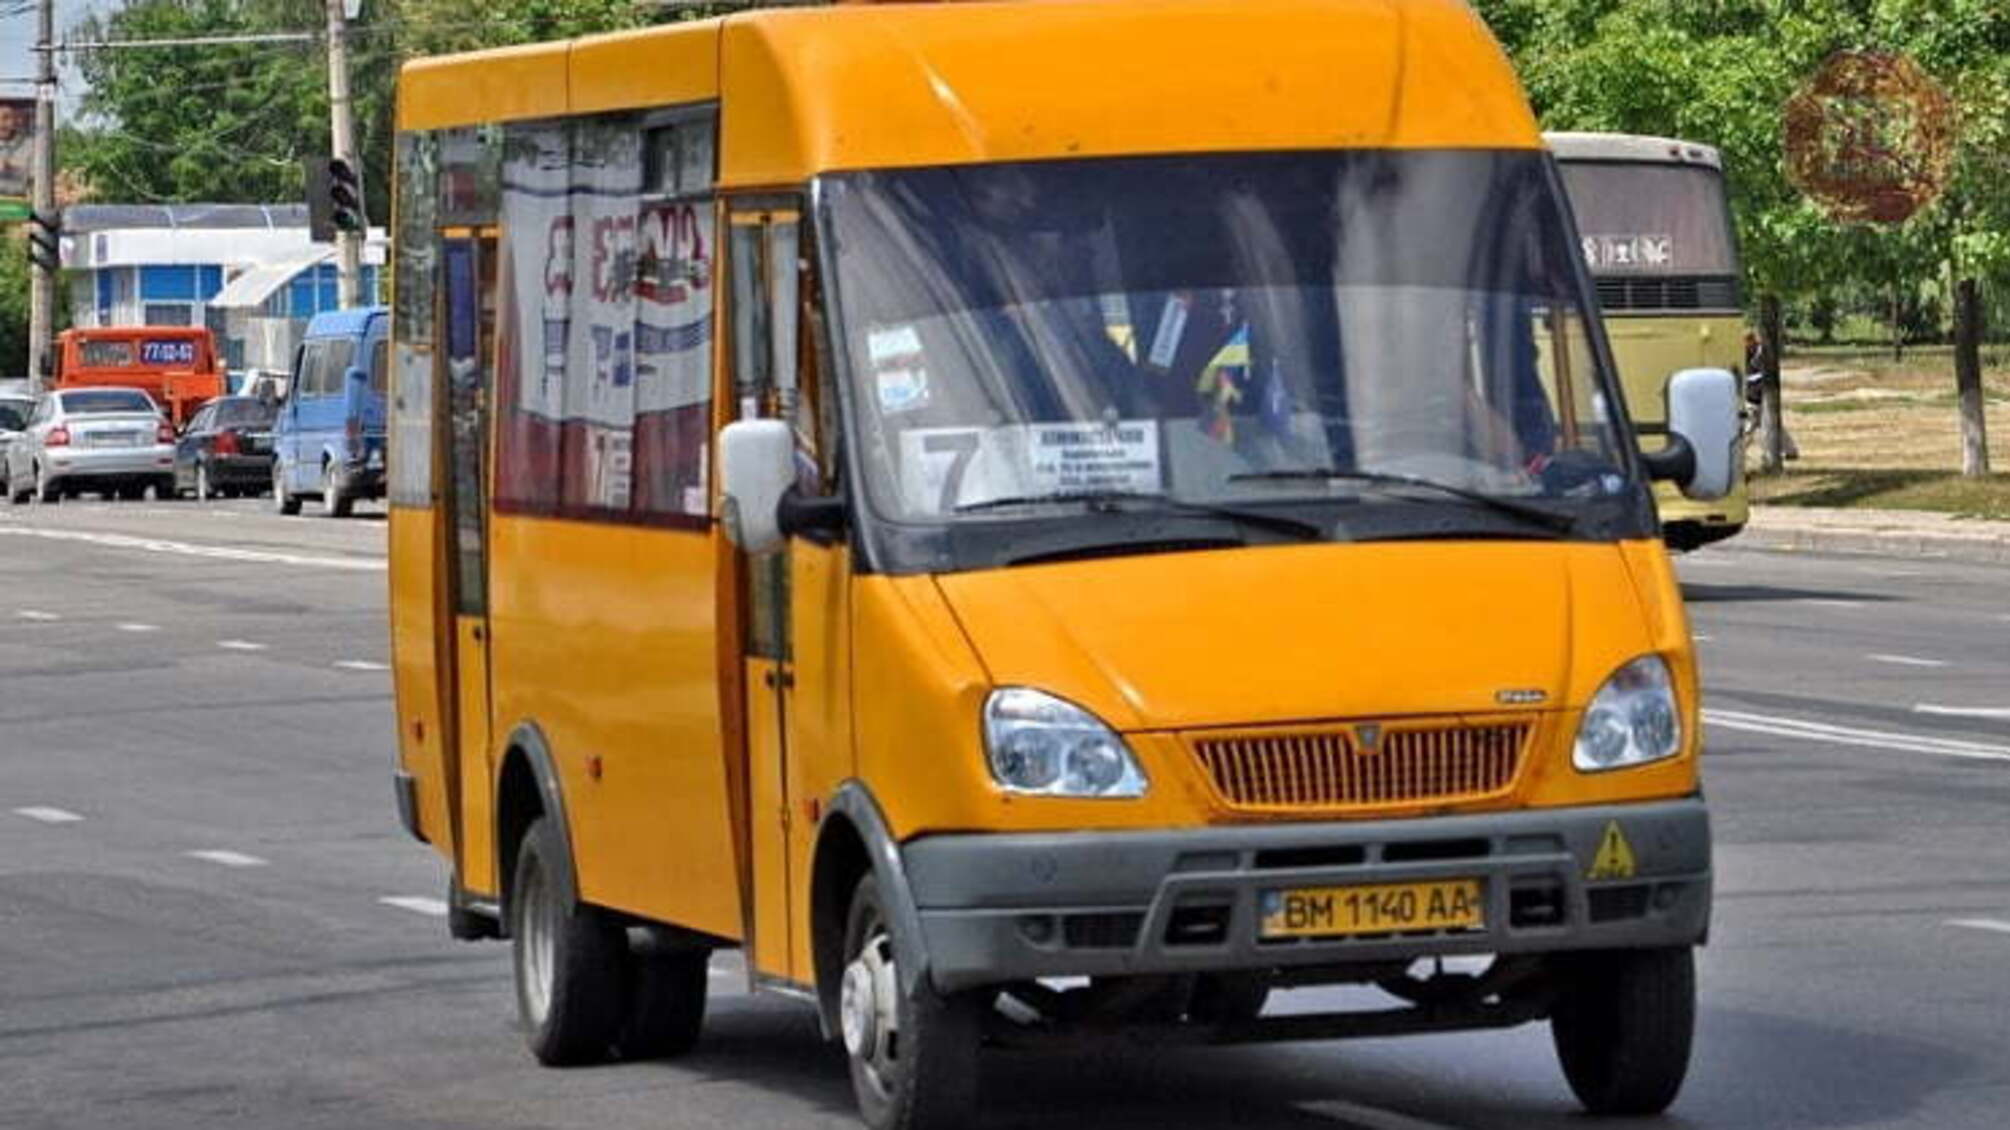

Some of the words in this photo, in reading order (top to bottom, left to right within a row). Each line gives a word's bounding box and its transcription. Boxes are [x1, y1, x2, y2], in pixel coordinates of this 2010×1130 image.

[924, 433, 980, 512] 7
[1284, 893, 1334, 929] BM
[1345, 890, 1418, 926] 1140
[1426, 887, 1472, 920] AA
